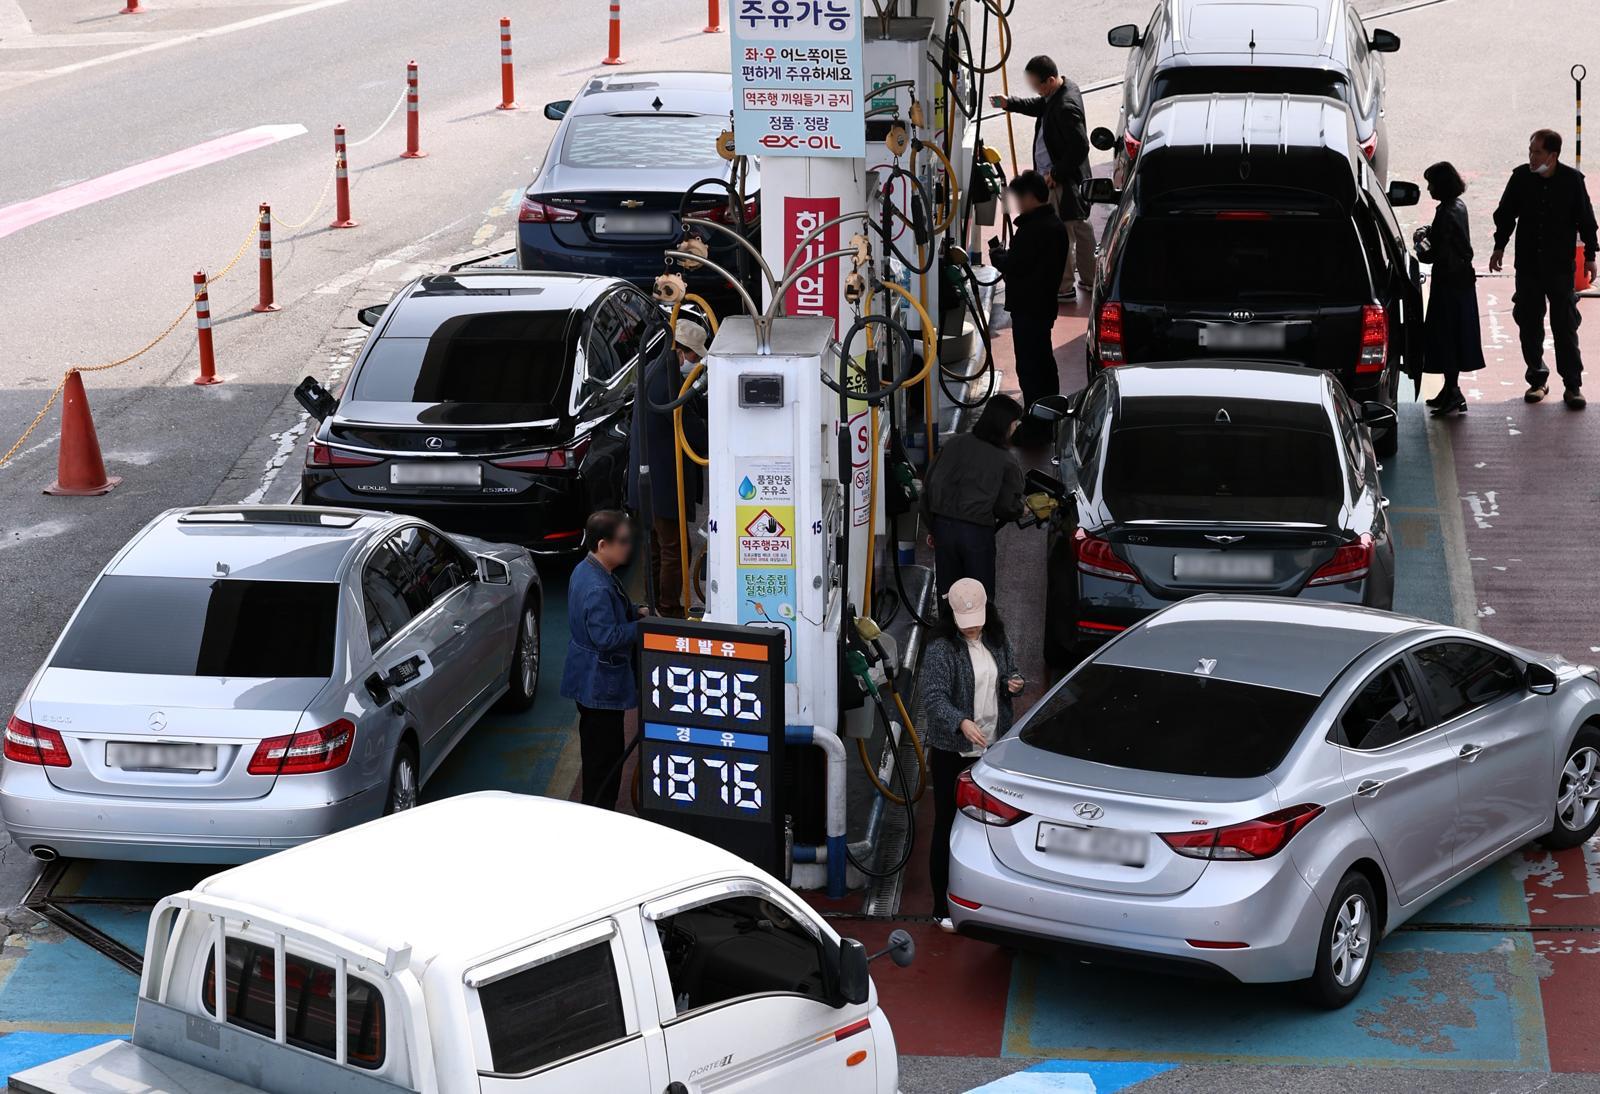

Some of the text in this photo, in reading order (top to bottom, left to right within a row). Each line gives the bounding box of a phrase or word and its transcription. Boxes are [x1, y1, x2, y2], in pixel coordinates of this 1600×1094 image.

[740, 0, 851, 31] 주유가능
[781, 48, 848, 65] 어느쪽이든
[742, 66, 852, 81] 편하게 주유하세요
[746, 92, 850, 108] 역주행 끼워들기 금지
[769, 116, 829, 132] 정품 정량
[1233, 311, 1251, 319] KIA
[761, 485, 788, 496] 주유소
[709, 519, 718, 533] 14
[812, 520, 822, 535] 15
[742, 539, 790, 551] 역주행금지
[745, 574, 787, 586] 탄소중립
[745, 585, 788, 597] 실천하기
[651, 665, 762, 721] 1986
[652, 753, 763, 810] 1876
